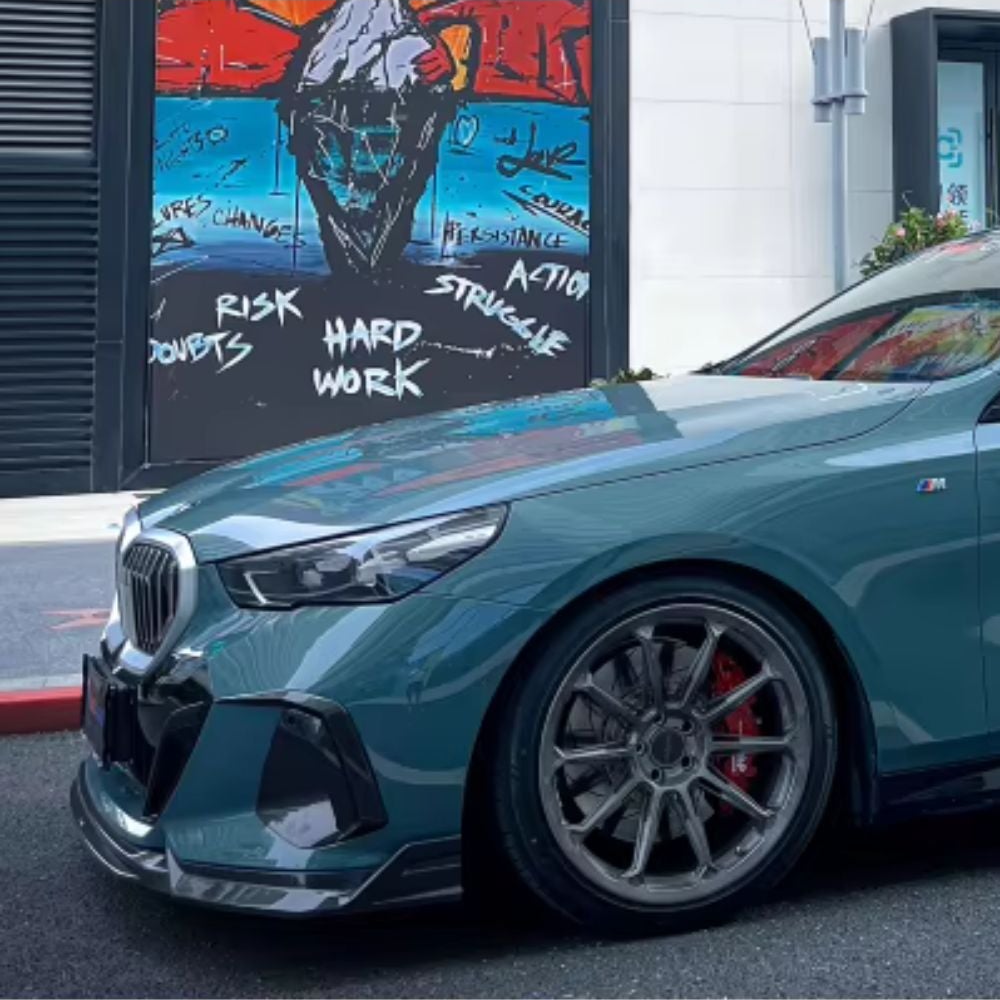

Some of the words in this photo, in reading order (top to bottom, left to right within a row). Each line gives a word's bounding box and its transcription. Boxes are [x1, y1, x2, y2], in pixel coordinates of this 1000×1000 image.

[496, 122, 586, 181] Love
[216, 287, 303, 328] RISK
[423, 274, 572, 359] STRUGGLE
[323, 316, 422, 359] HARD
[313, 357, 431, 401] WORK
